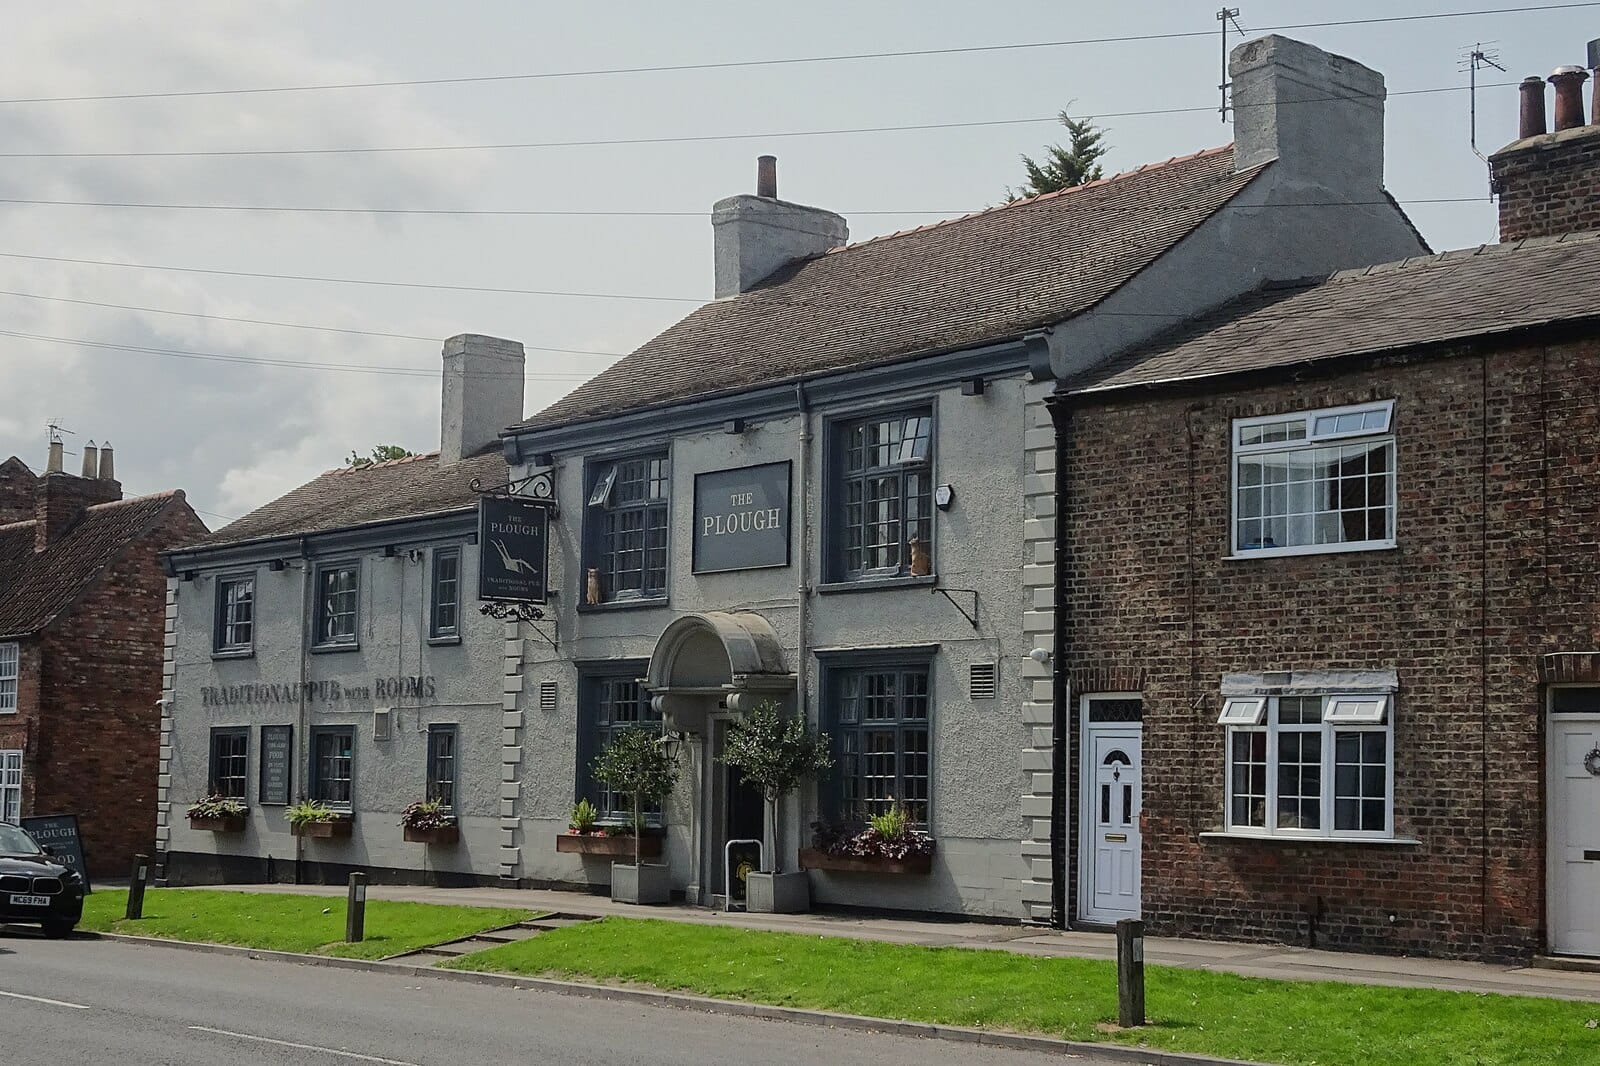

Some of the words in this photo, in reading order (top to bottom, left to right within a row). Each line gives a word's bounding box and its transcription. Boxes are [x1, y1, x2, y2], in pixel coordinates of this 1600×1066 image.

[731, 492, 753, 507] THE
[507, 515, 522, 523] THE
[703, 508, 781, 537] PLOUGH
[491, 522, 539, 536] PLOUGH
[200, 682, 300, 707] TRADITIONAL
[306, 680, 341, 702] PUB
[375, 676, 436, 699] ROOMS
[29, 827, 76, 840] PLOUGH
